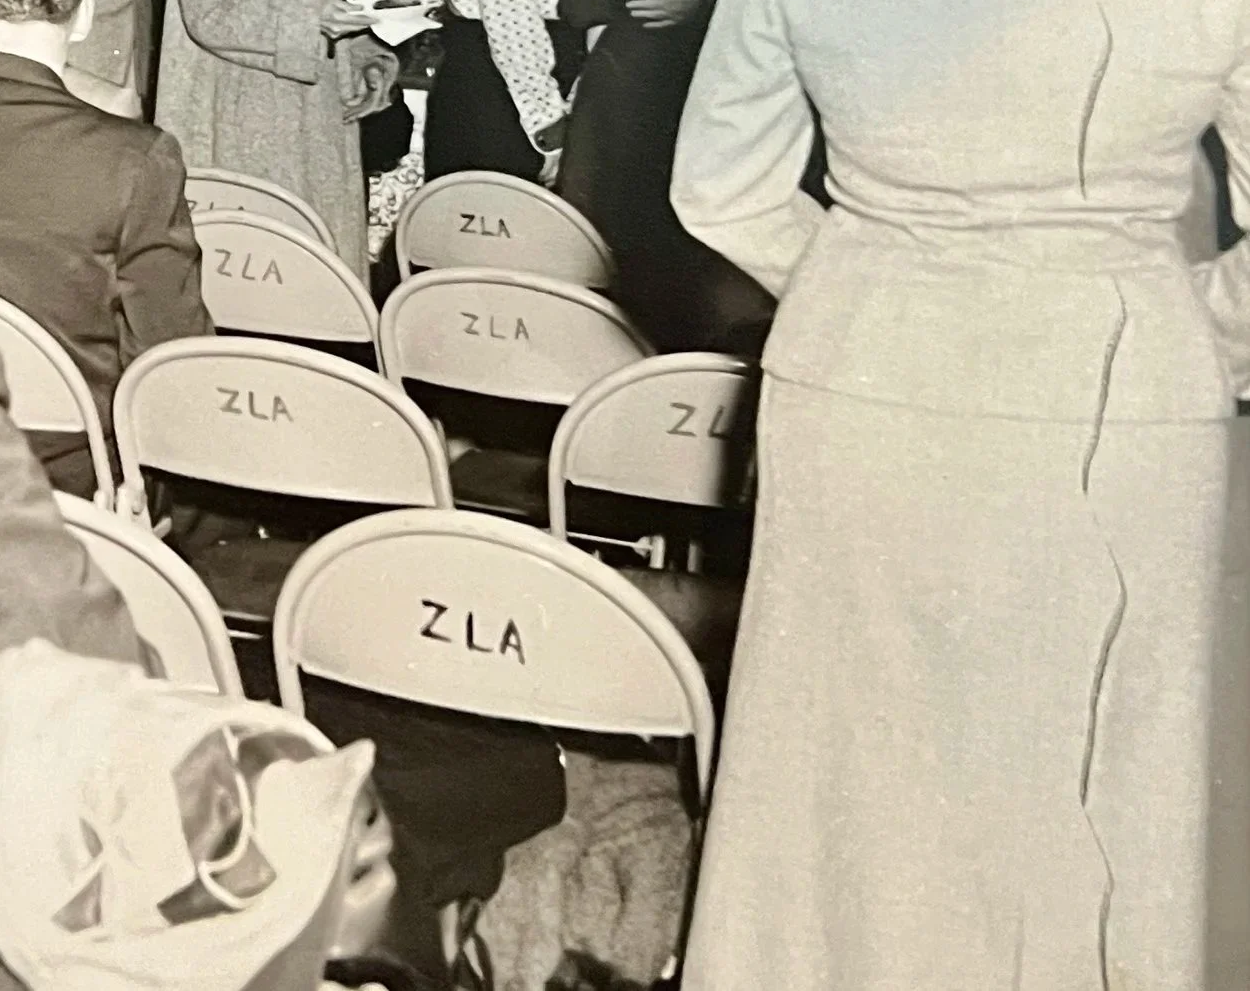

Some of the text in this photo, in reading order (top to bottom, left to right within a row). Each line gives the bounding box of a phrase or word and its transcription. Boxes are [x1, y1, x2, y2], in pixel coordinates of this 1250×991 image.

[460, 213, 511, 239] ZLA
[214, 248, 283, 285] ZLA
[460, 311, 530, 340] ZLA
[216, 387, 294, 422] ZLA
[666, 402, 732, 440] ZL
[420, 599, 526, 665] ZLA
